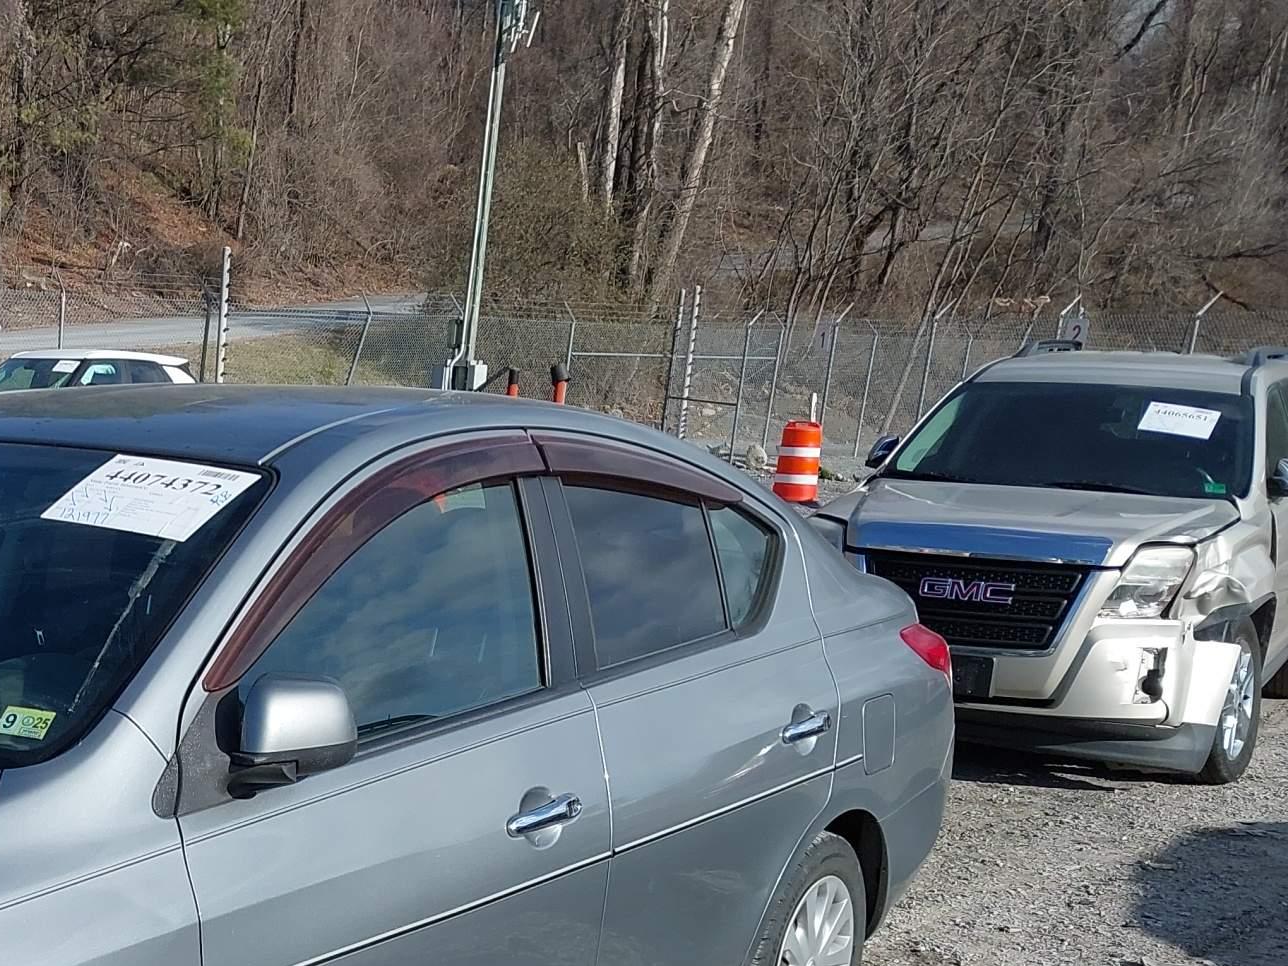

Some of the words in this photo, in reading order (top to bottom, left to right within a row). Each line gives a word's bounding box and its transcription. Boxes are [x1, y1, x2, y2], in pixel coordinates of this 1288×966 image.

[820, 331, 826, 349] 1
[1072, 324, 1082, 341] 2
[105, 469, 223, 496] 44074372
[918, 576, 1017, 604] GMC
[2, 713, 18, 729] 9
[31, 716, 51, 730] 25
